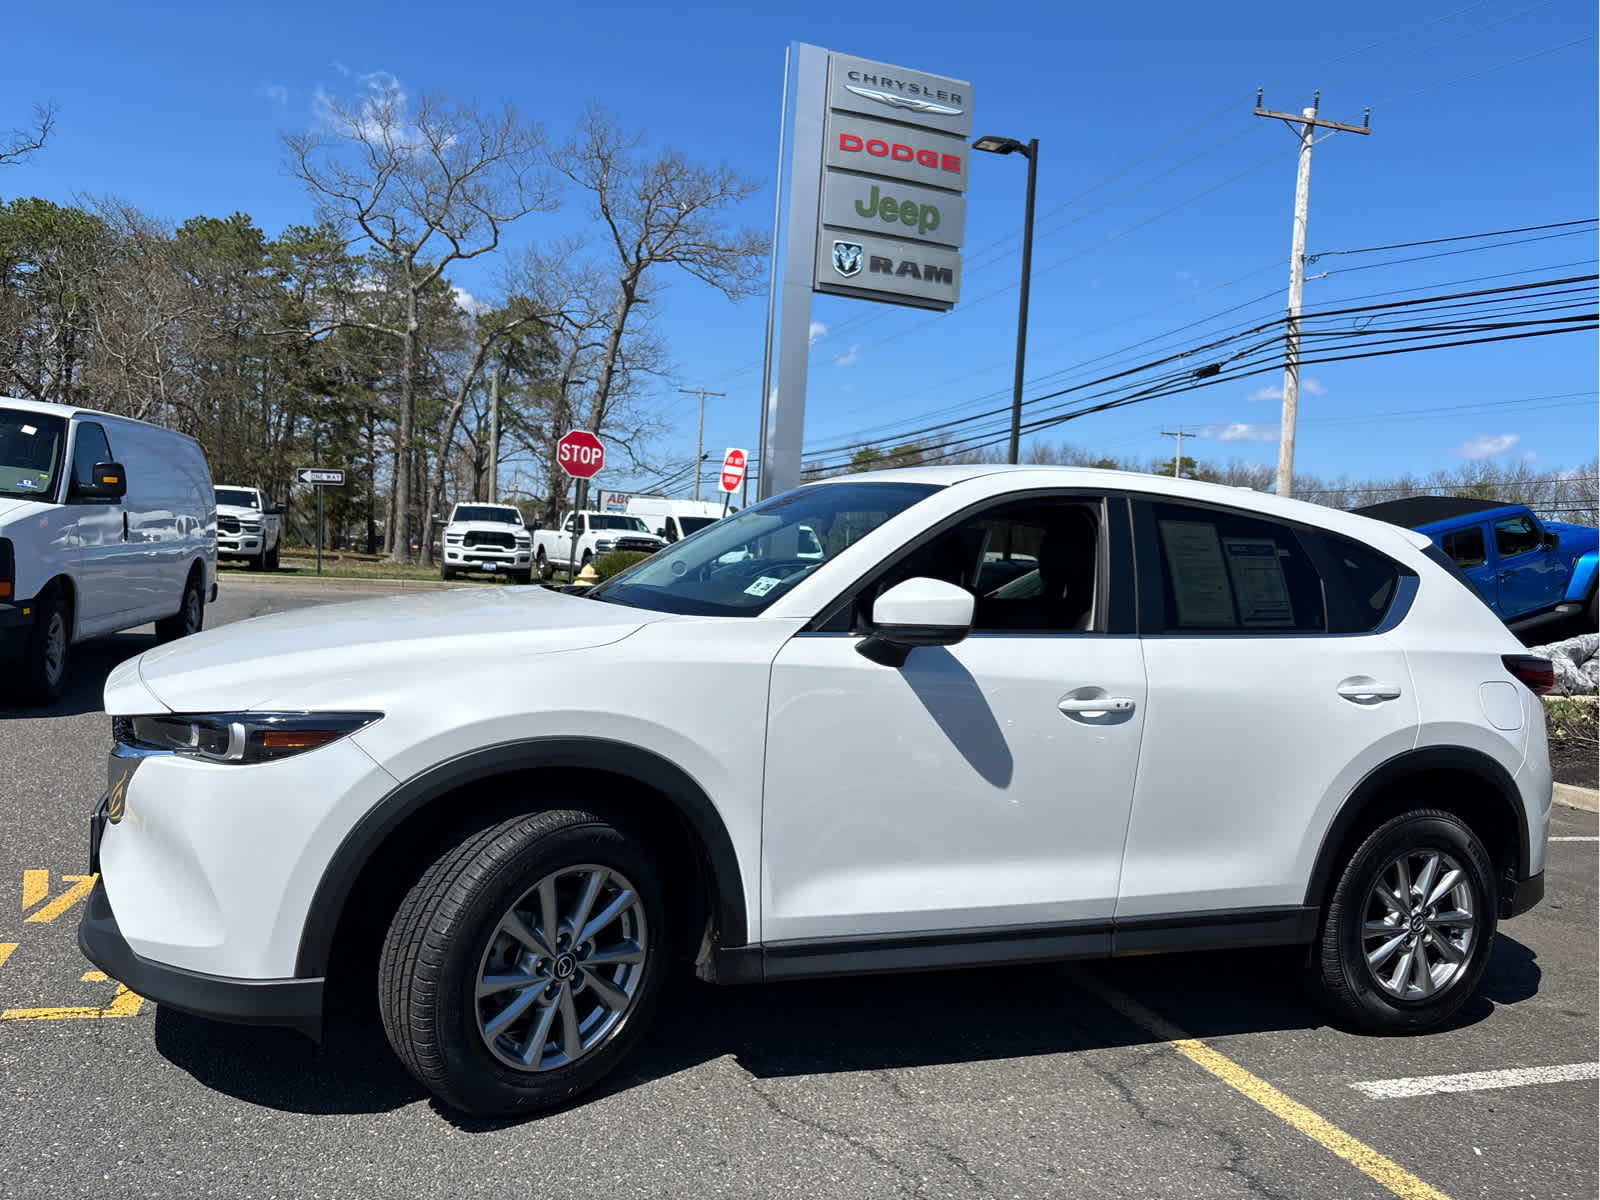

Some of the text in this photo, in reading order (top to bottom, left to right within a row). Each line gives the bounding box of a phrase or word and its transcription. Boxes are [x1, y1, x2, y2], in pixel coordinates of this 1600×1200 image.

[848, 71, 962, 105] CHRYSLER
[839, 133, 961, 173] DODGE
[855, 185, 940, 235] Jeep
[869, 255, 953, 285] RAM
[560, 443, 602, 465] STOP
